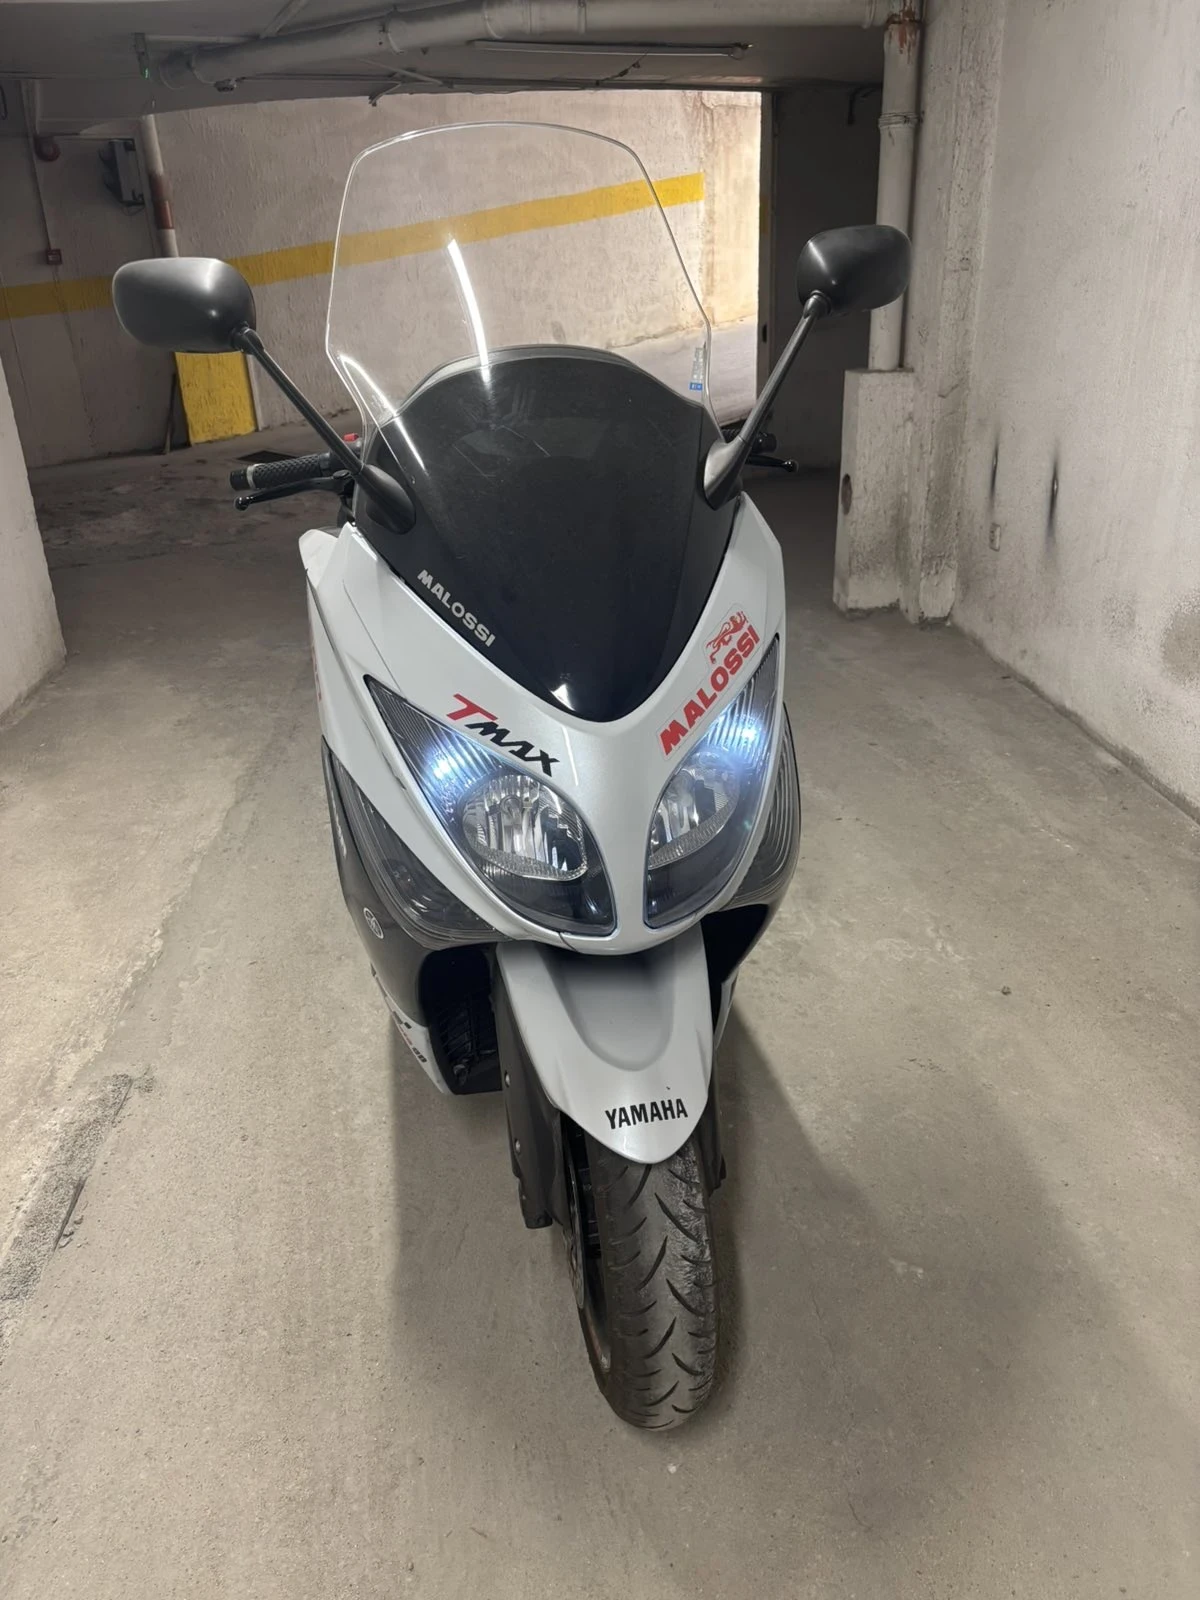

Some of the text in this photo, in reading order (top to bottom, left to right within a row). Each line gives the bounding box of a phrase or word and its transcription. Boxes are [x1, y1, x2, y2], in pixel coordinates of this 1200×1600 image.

[417, 569, 496, 647] MALOSSI
[660, 624, 760, 756] MALOSSI
[605, 1098, 688, 1129] YAMAHA
